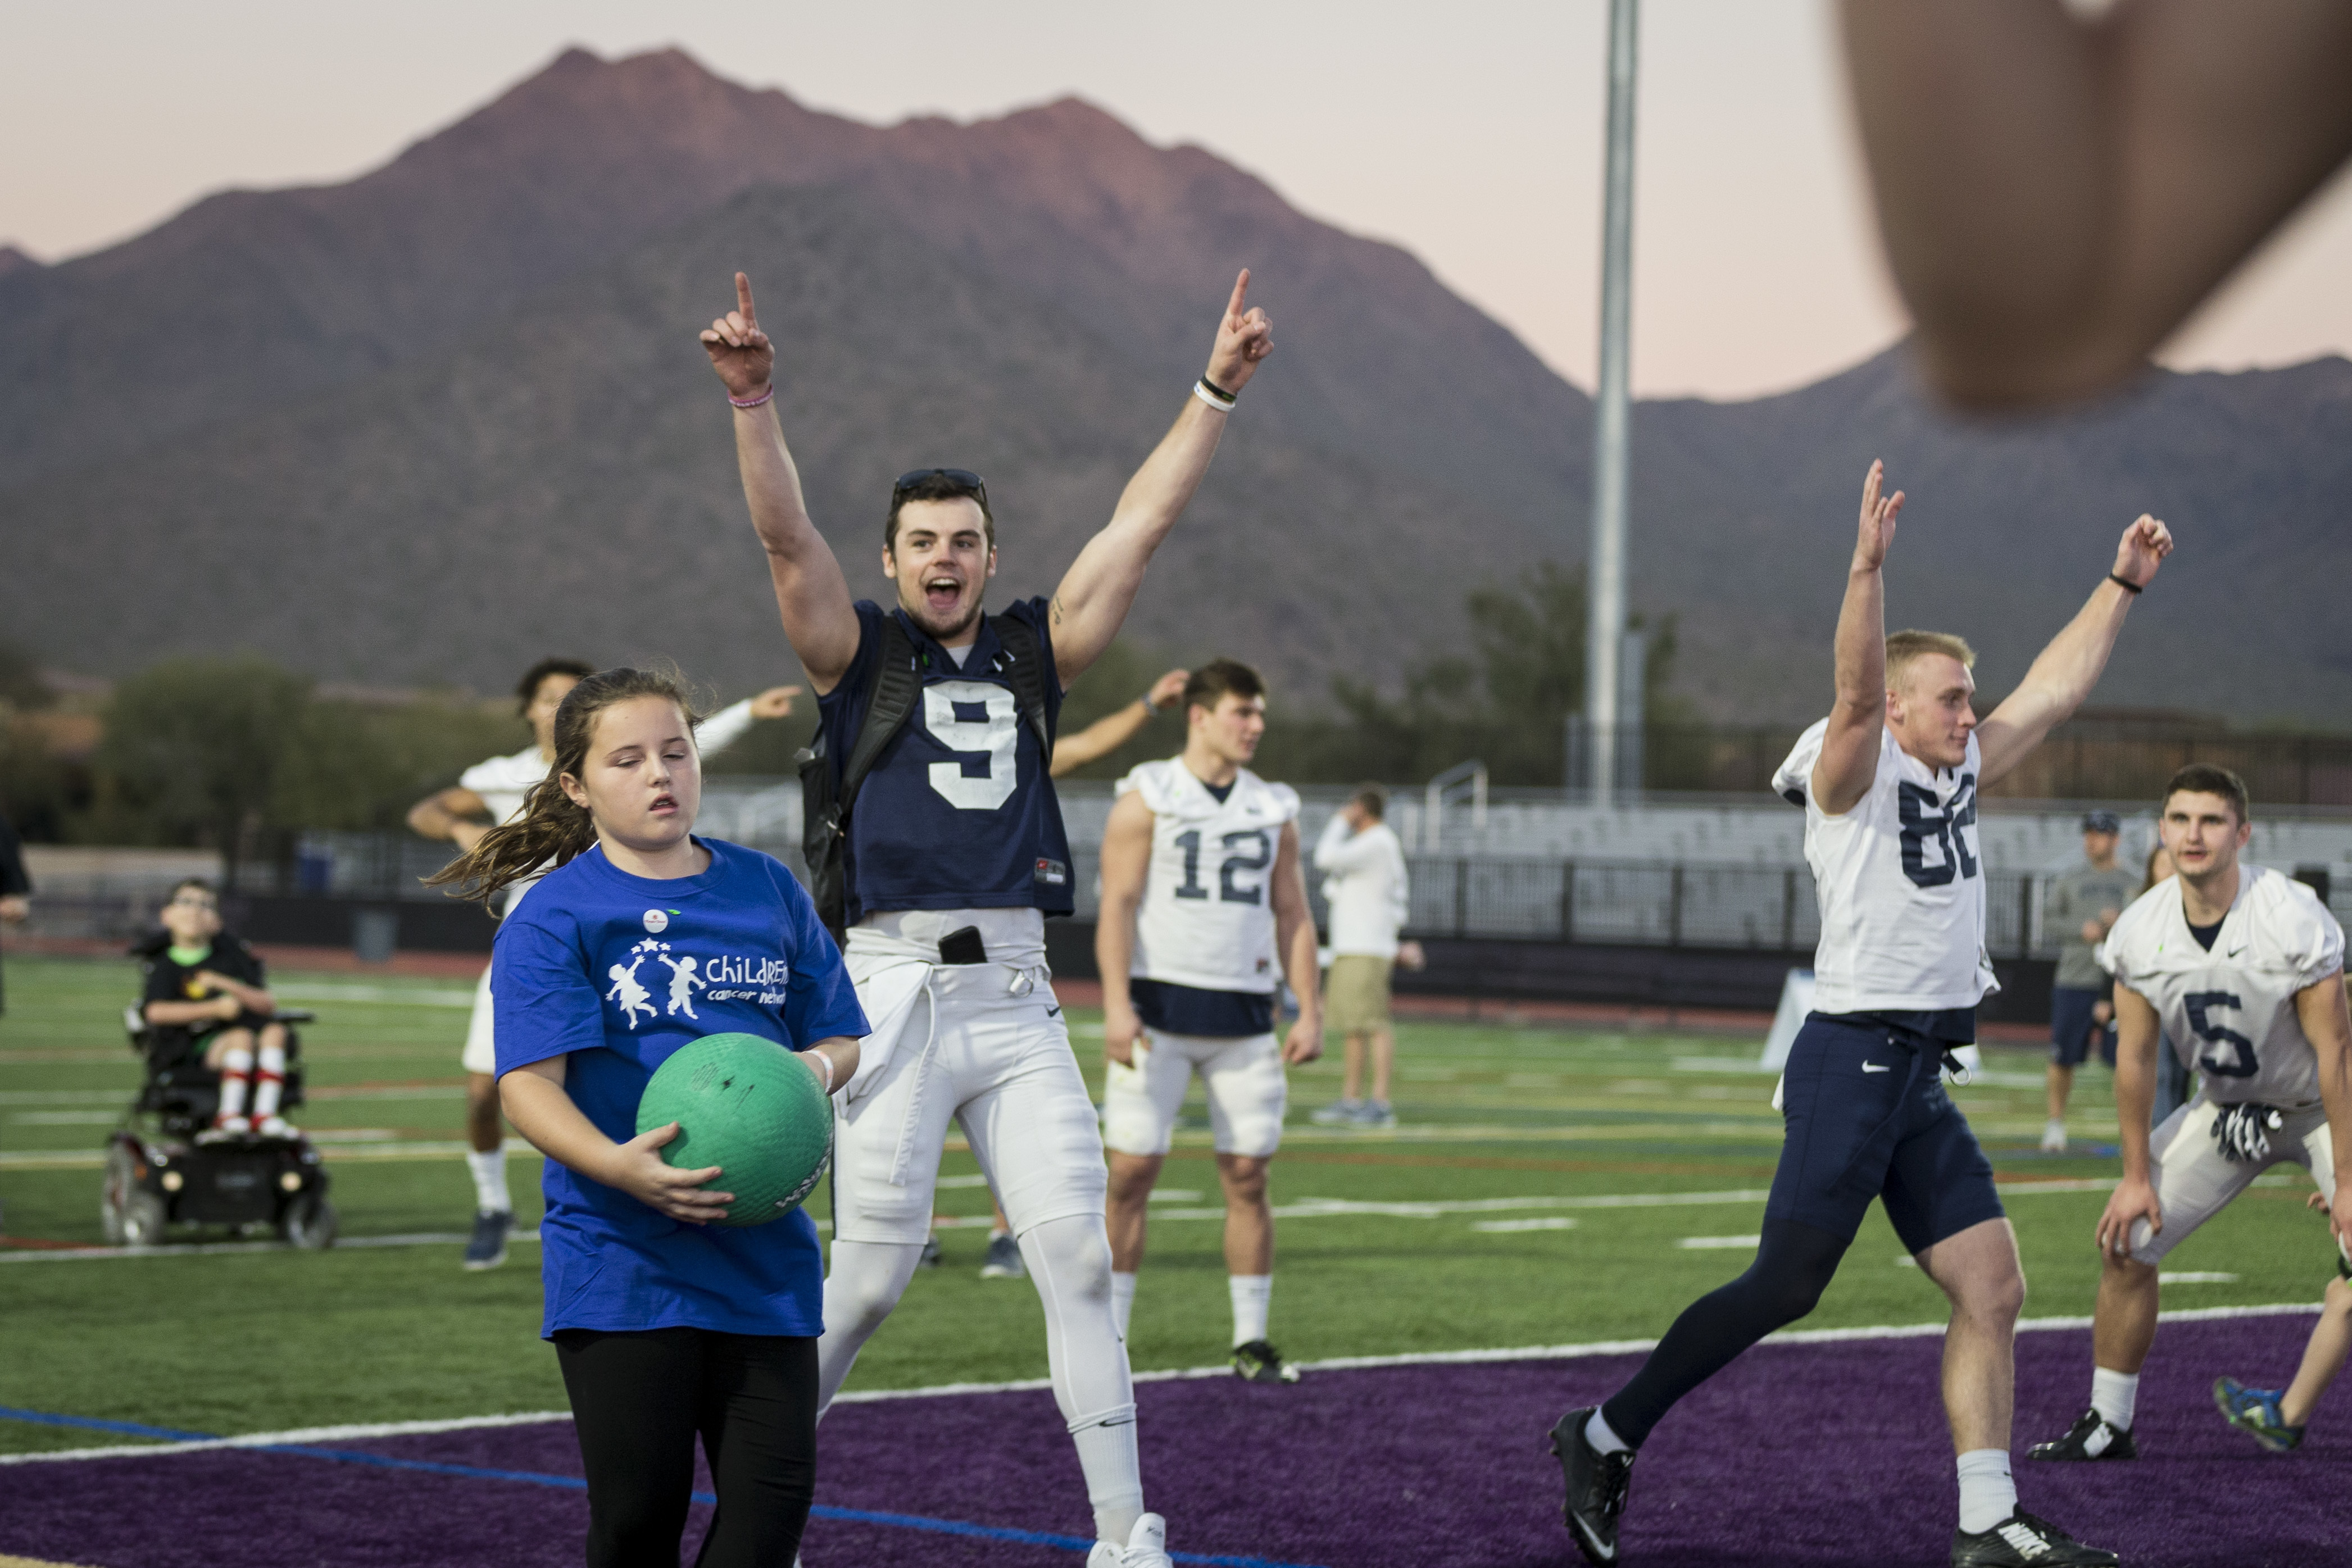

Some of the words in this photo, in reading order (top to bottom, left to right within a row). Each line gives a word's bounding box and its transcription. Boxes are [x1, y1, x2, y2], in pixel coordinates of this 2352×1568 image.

[923, 679, 1018, 810] 9
[1174, 828, 1270, 906] 12
[707, 989, 757, 1000] cancer
[2183, 990, 2259, 1078] 5
[1997, 1522, 2053, 1561] NIKE
